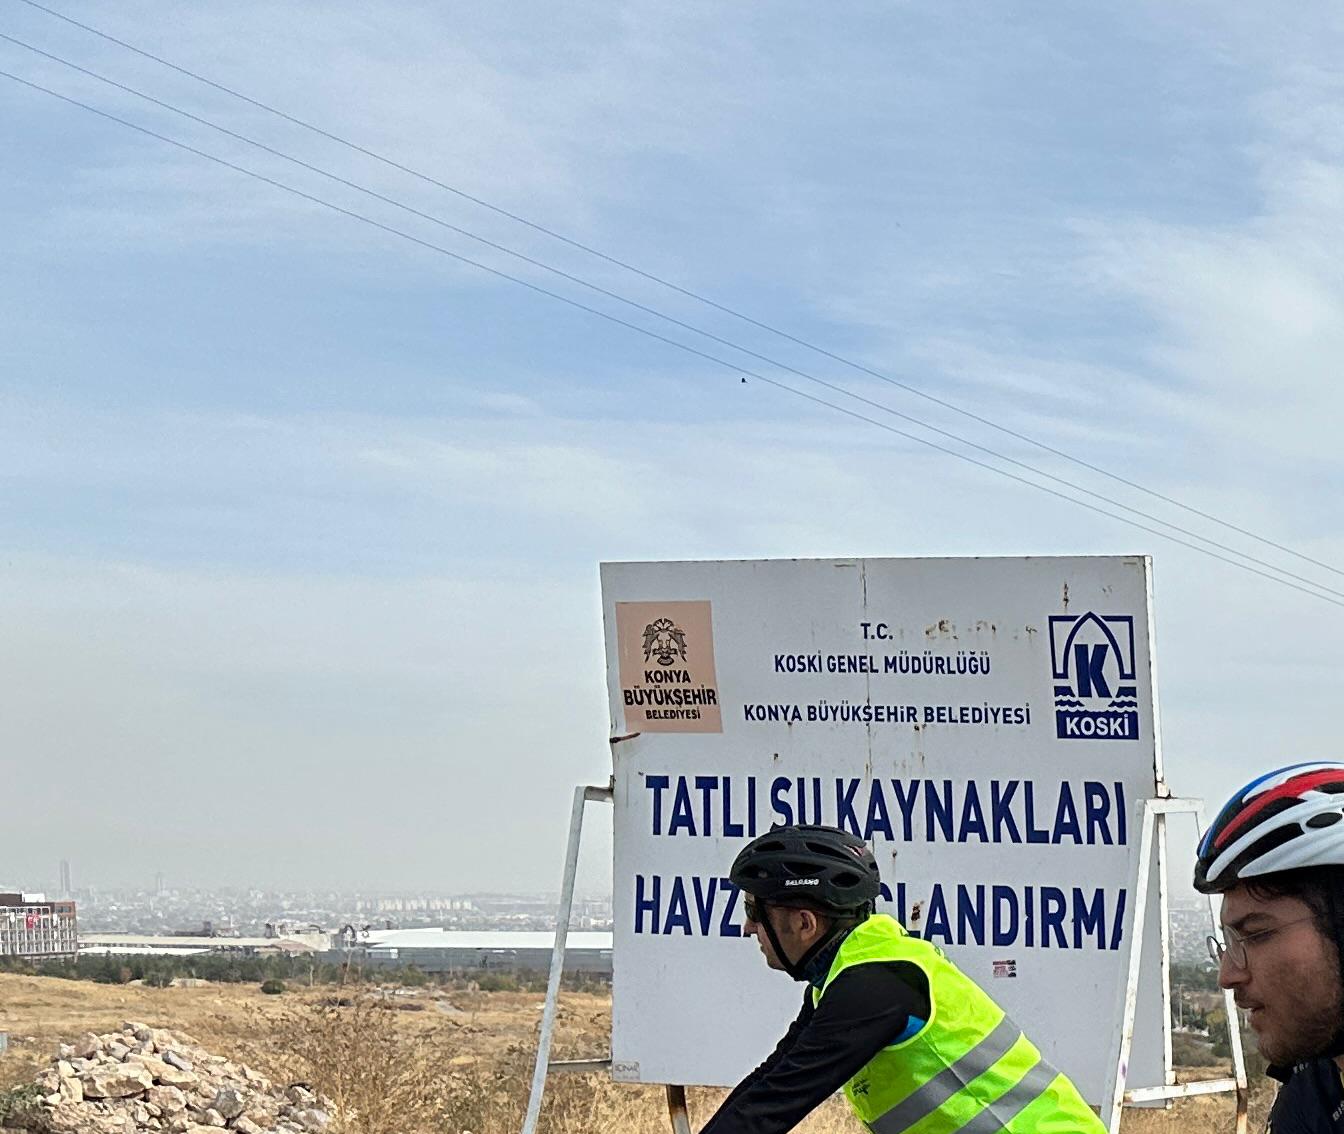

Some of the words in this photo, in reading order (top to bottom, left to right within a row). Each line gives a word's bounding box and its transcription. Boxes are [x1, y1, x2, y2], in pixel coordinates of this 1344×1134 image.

[860, 622, 894, 640] T.C.
[774, 650, 823, 673] KOSKİ
[826, 655, 879, 674] GENEL
[884, 650, 991, 675] MÜDÜRLÜĞÜ
[644, 669, 691, 684] KONYA
[623, 685, 717, 707] BÜYÜKŞEHİR
[646, 706, 701, 720] BELEDİYESİ
[743, 704, 802, 722] KONYA
[924, 702, 1031, 725] BELEDİYESİ
[1065, 713, 1130, 736] KOSKİ
[645, 775, 757, 837] TATLI
[770, 776, 822, 827] SU
[835, 778, 1127, 845] KAYNAKLARI
[634, 874, 752, 937] HAVZ
